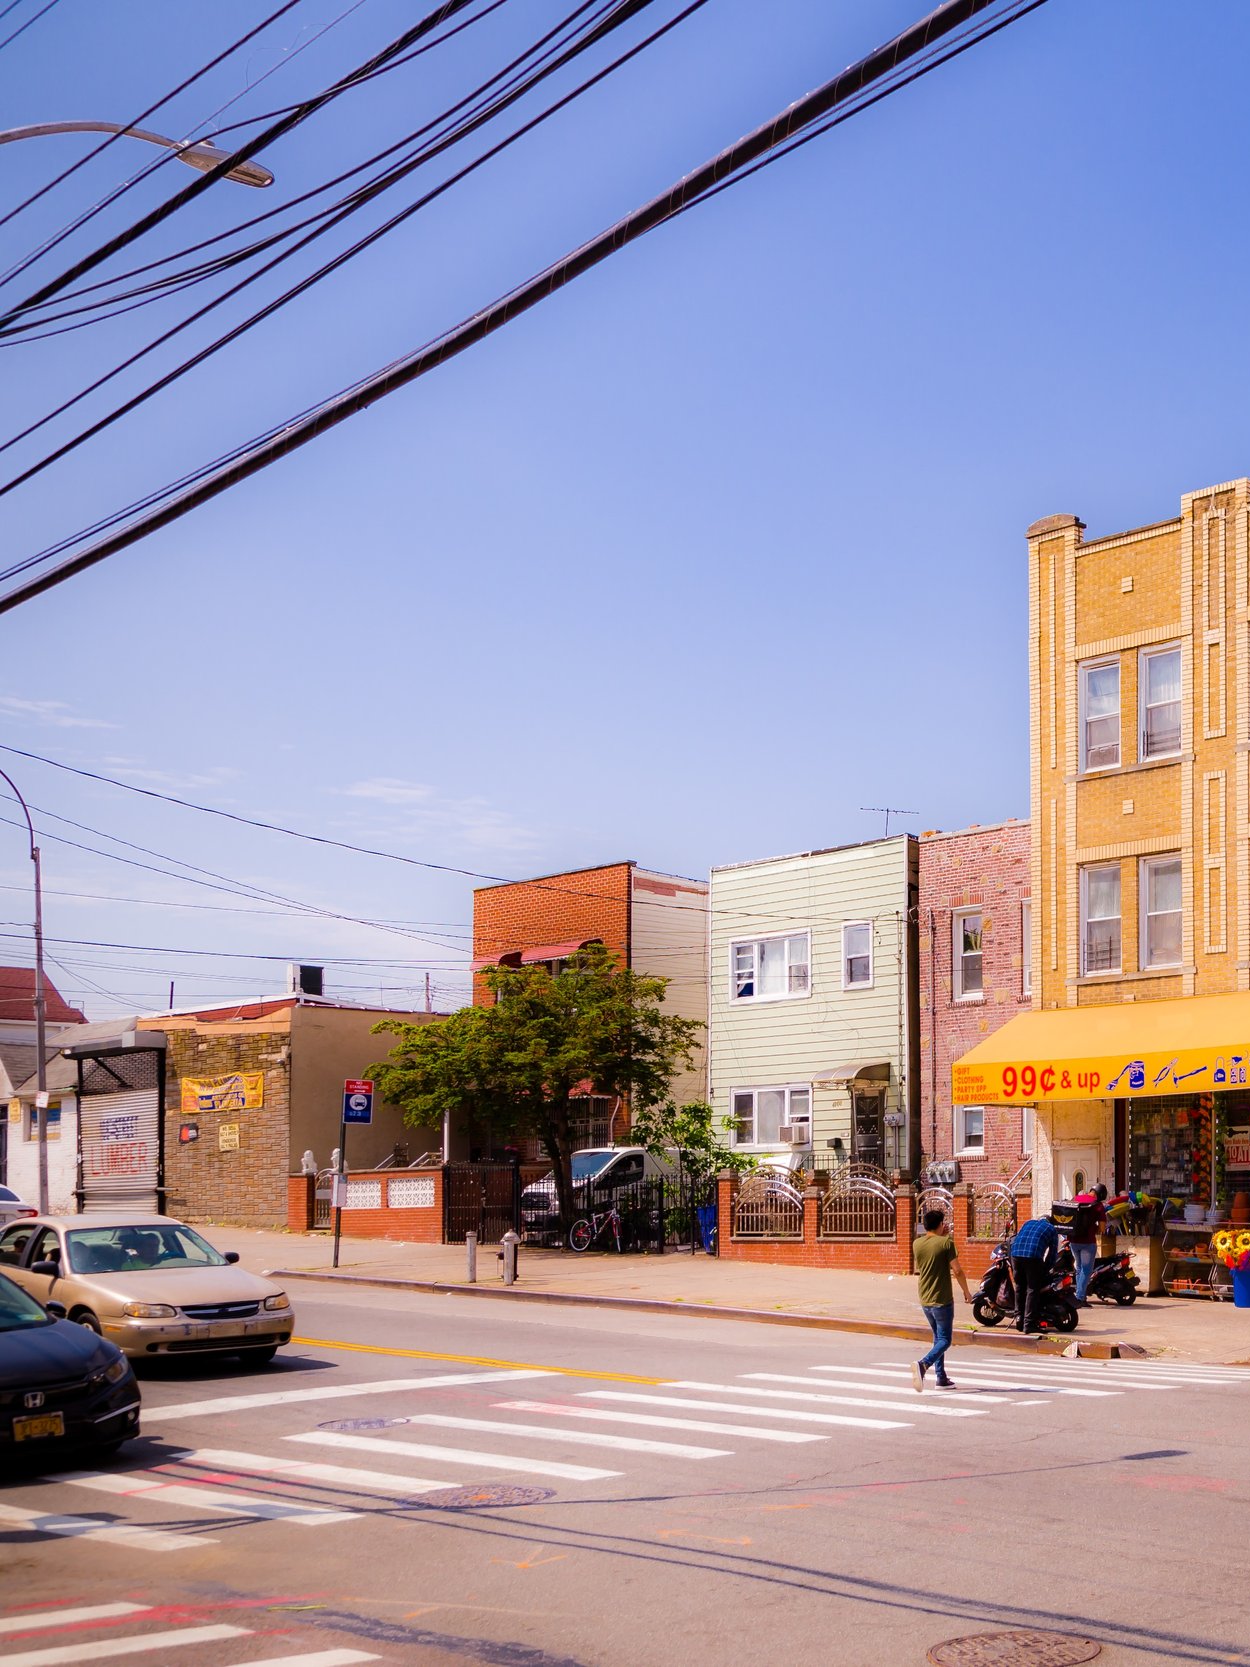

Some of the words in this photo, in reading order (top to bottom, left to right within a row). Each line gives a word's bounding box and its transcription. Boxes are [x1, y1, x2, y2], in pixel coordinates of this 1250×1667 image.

[957, 1076, 984, 1084] CLOTHING
[1002, 1065, 1055, 1098] 99¢
[1061, 1070, 1072, 1089] &
[1078, 1072, 1100, 1093] up
